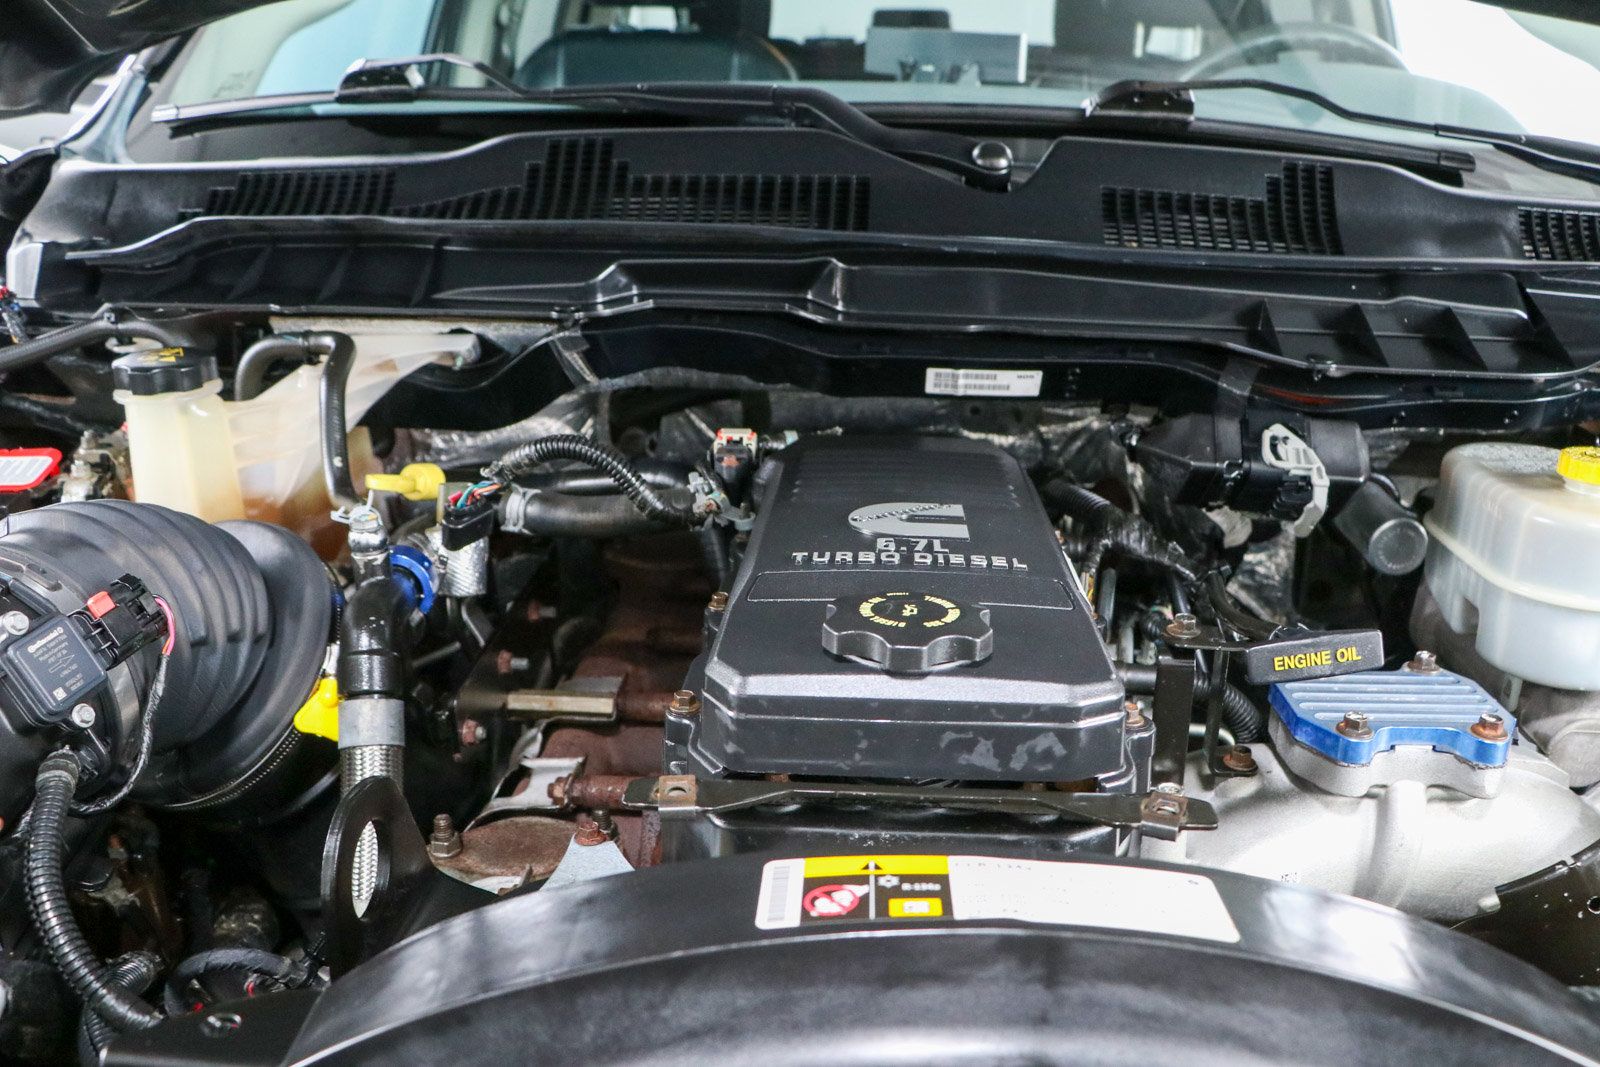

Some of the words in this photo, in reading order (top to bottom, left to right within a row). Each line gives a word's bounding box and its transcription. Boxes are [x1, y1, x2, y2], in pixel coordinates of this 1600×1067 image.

[876, 538, 949, 554] 6.7L
[791, 551, 901, 566] TURBO
[913, 552, 1029, 571] DIESEL
[1273, 650, 1332, 671] ENGINE
[1336, 646, 1362, 663] OIL
